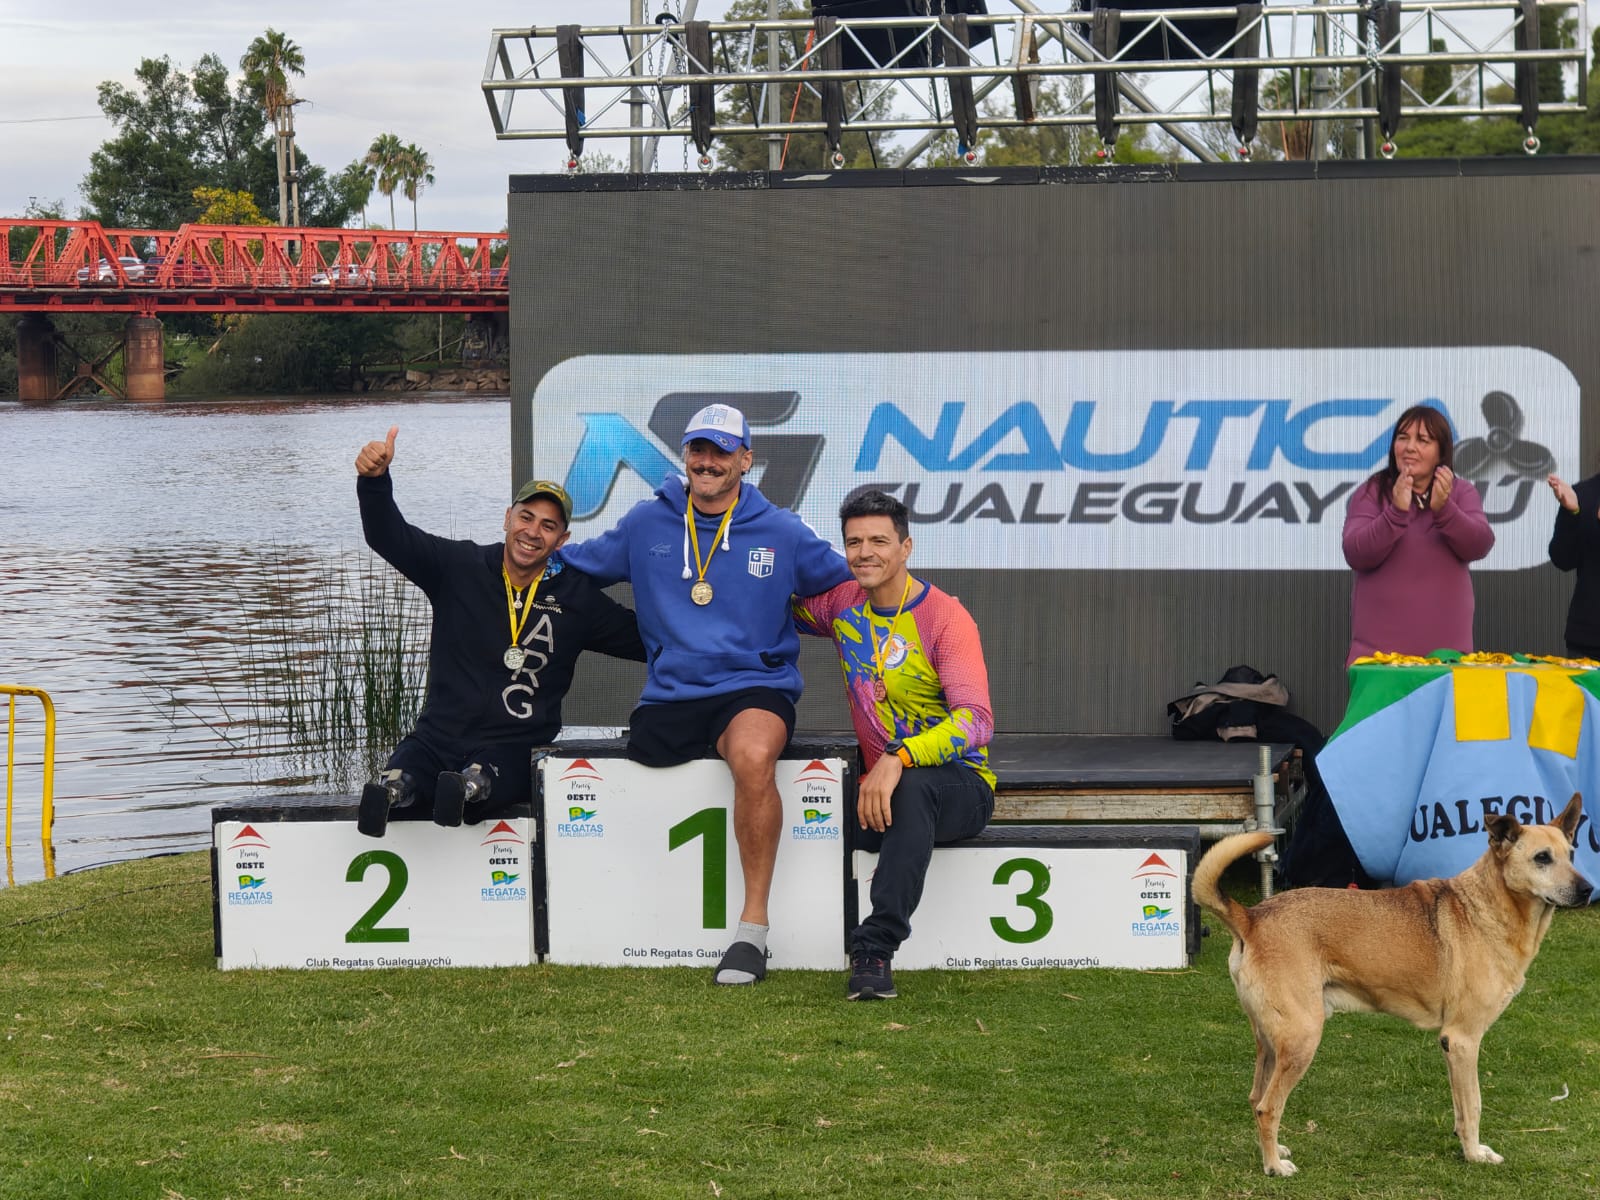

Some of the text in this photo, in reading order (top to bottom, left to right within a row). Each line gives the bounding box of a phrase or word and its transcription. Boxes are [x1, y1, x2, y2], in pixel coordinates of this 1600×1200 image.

[841, 474, 1536, 525] UALEGUAYÚ
[567, 793, 597, 801] OESTE
[557, 824, 604, 833] REGATAS
[792, 826, 839, 835] REGATAS
[236, 861, 265, 869] OESTE
[489, 857, 519, 865] OESTE
[669, 808, 727, 929] 1
[228, 891, 273, 900] REGATAS
[345, 850, 410, 943] 2
[481, 887, 526, 897] REGATAS
[1140, 891, 1171, 899] OESTE
[989, 857, 1054, 944] 3
[1132, 922, 1180, 931] REGATAS
[623, 947, 648, 957] Club
[650, 947, 693, 960] Regatas
[305, 955, 452, 969] Club Regatas Gualeguaychú
[946, 955, 1100, 969] Club Regatas Gualeguaychú
